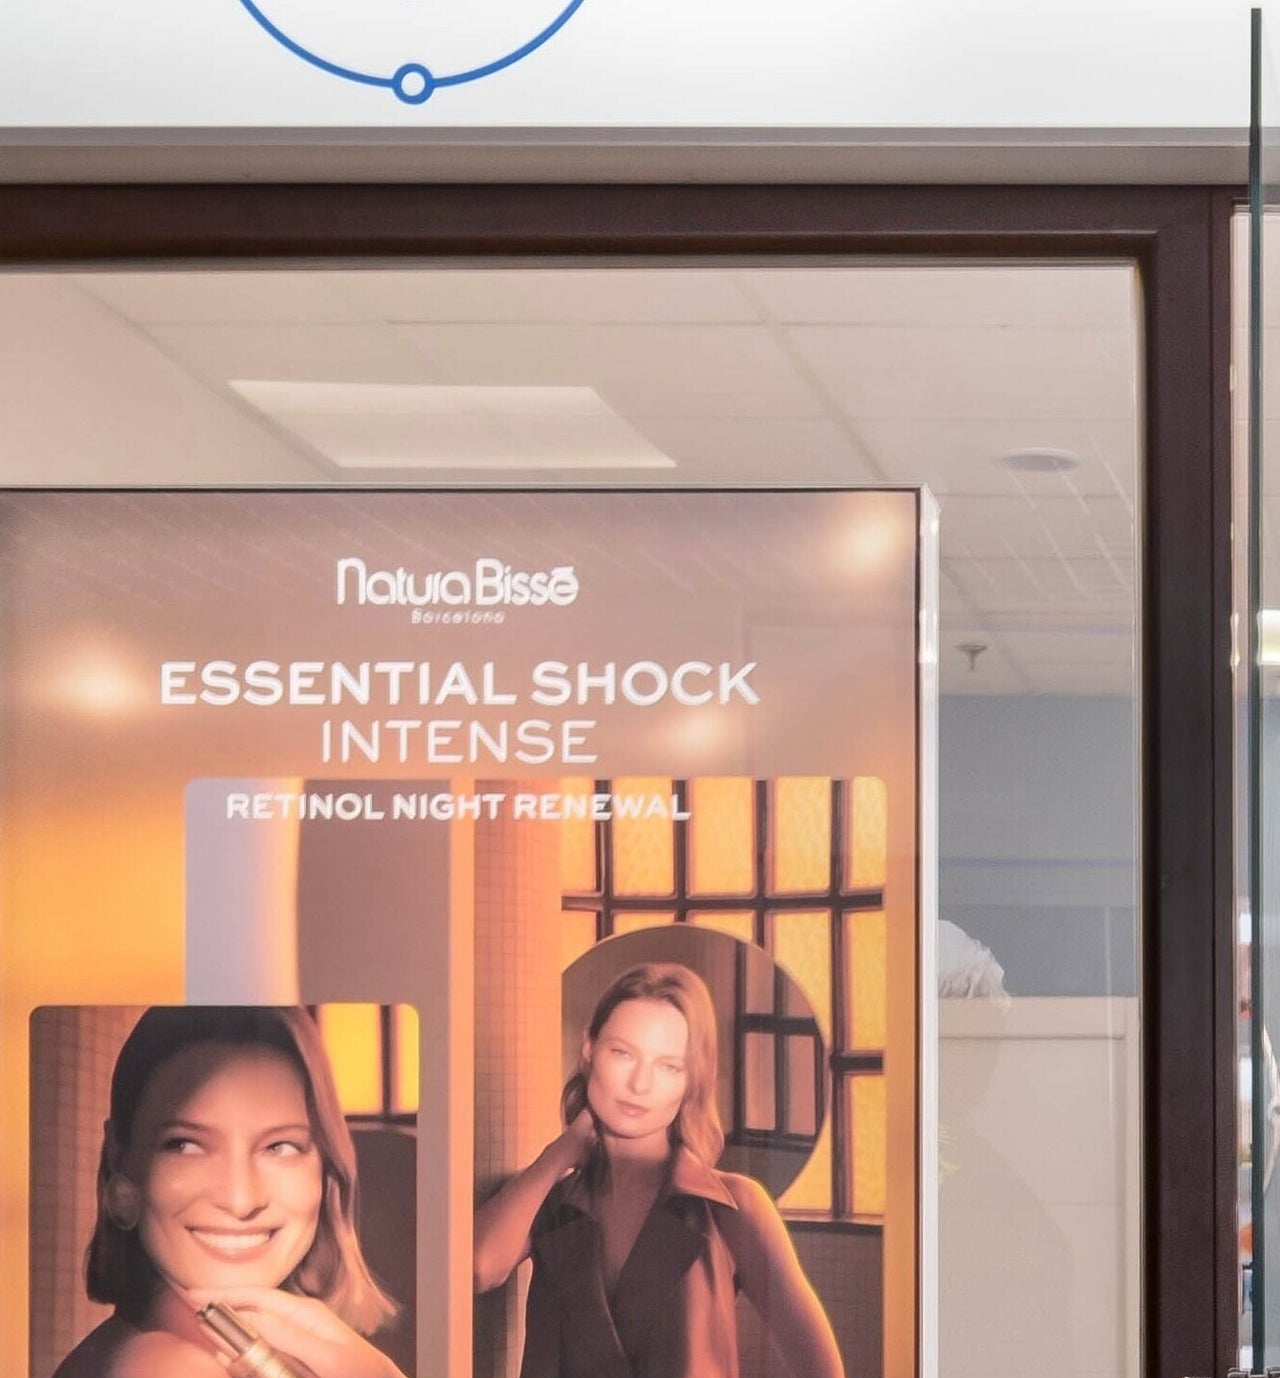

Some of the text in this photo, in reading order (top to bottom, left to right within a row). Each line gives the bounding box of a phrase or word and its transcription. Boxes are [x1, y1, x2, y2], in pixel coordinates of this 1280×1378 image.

[336, 557, 472, 606] Natura
[160, 660, 761, 706] ESSENTIAL SHOCK
[321, 718, 598, 764] INTENSE
[225, 791, 693, 822] RETINOL NIGHT RENEWAL
